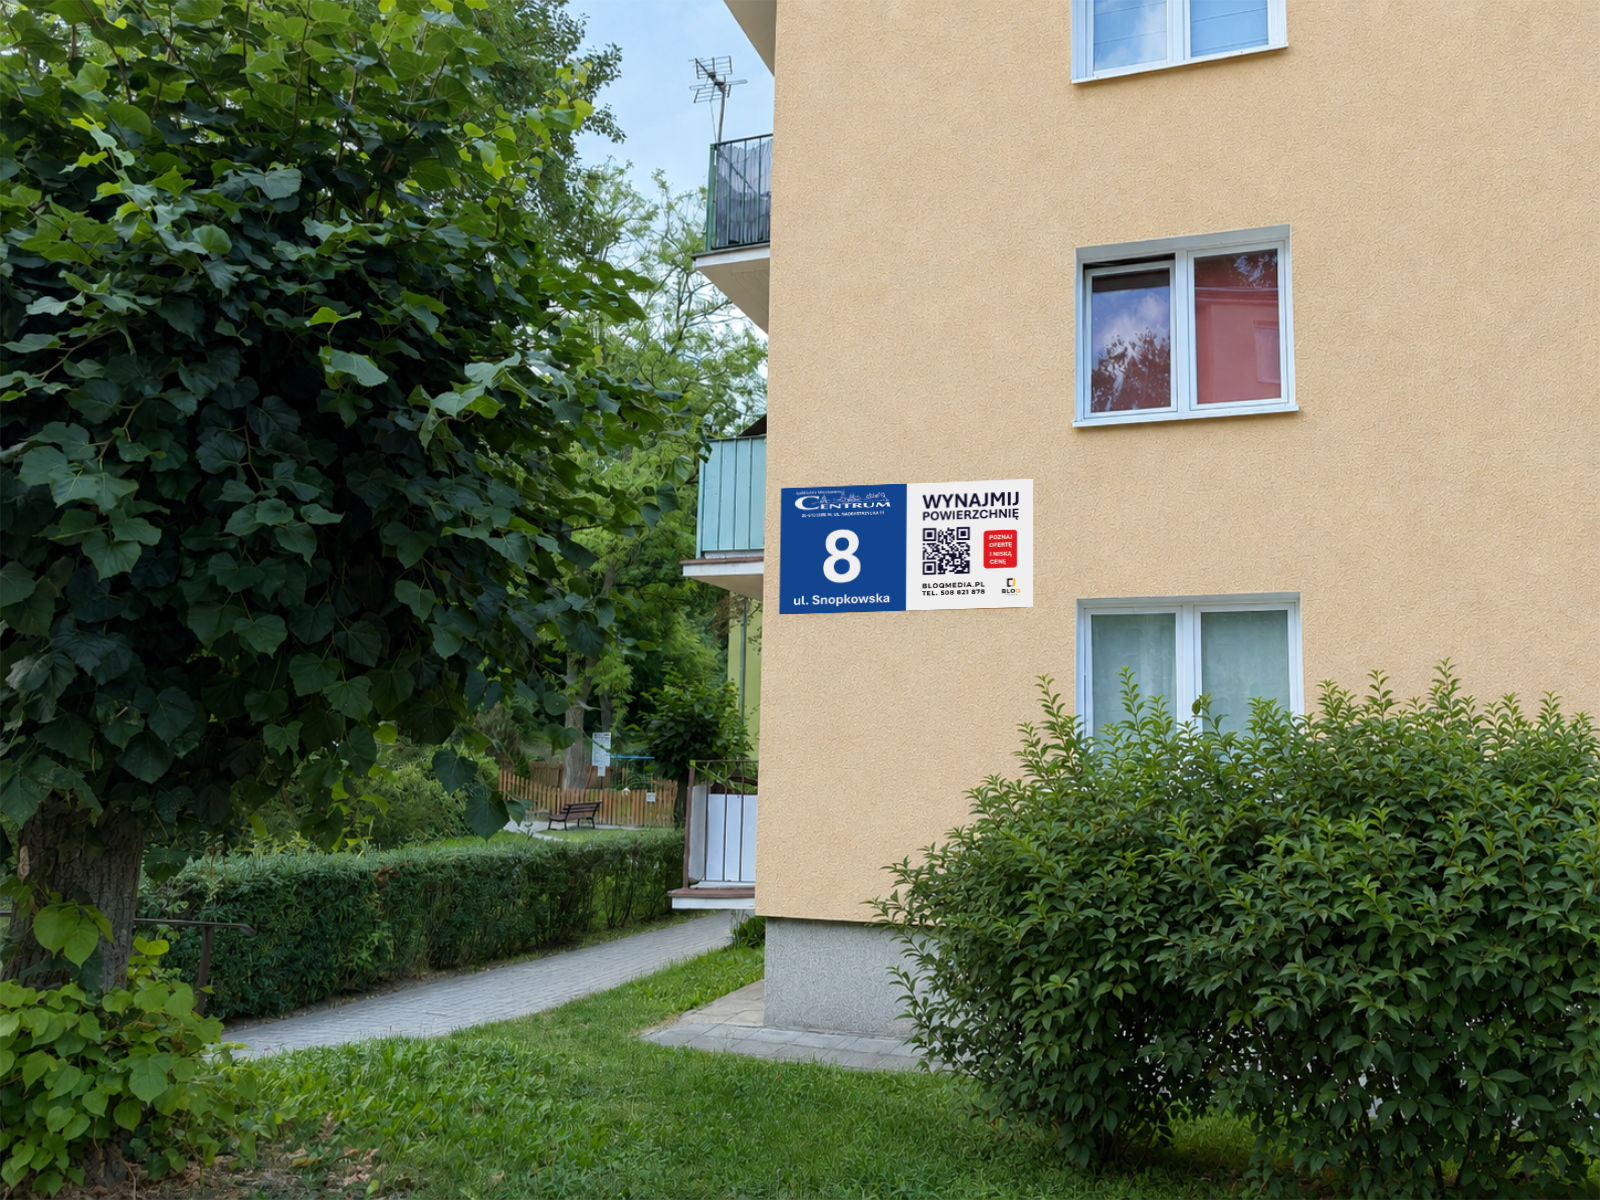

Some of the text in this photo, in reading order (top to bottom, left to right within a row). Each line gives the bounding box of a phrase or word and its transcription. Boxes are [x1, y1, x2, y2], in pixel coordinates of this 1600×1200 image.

[794, 495, 891, 511] CENTRUM
[922, 492, 1019, 509] WYNAJMIJ
[922, 509, 1019, 521] POWIERZCHNIĘ
[823, 529, 861, 583] 8
[922, 581, 985, 589] BLOQMEDIA.PL
[793, 593, 890, 607] ul. Snopkowska
